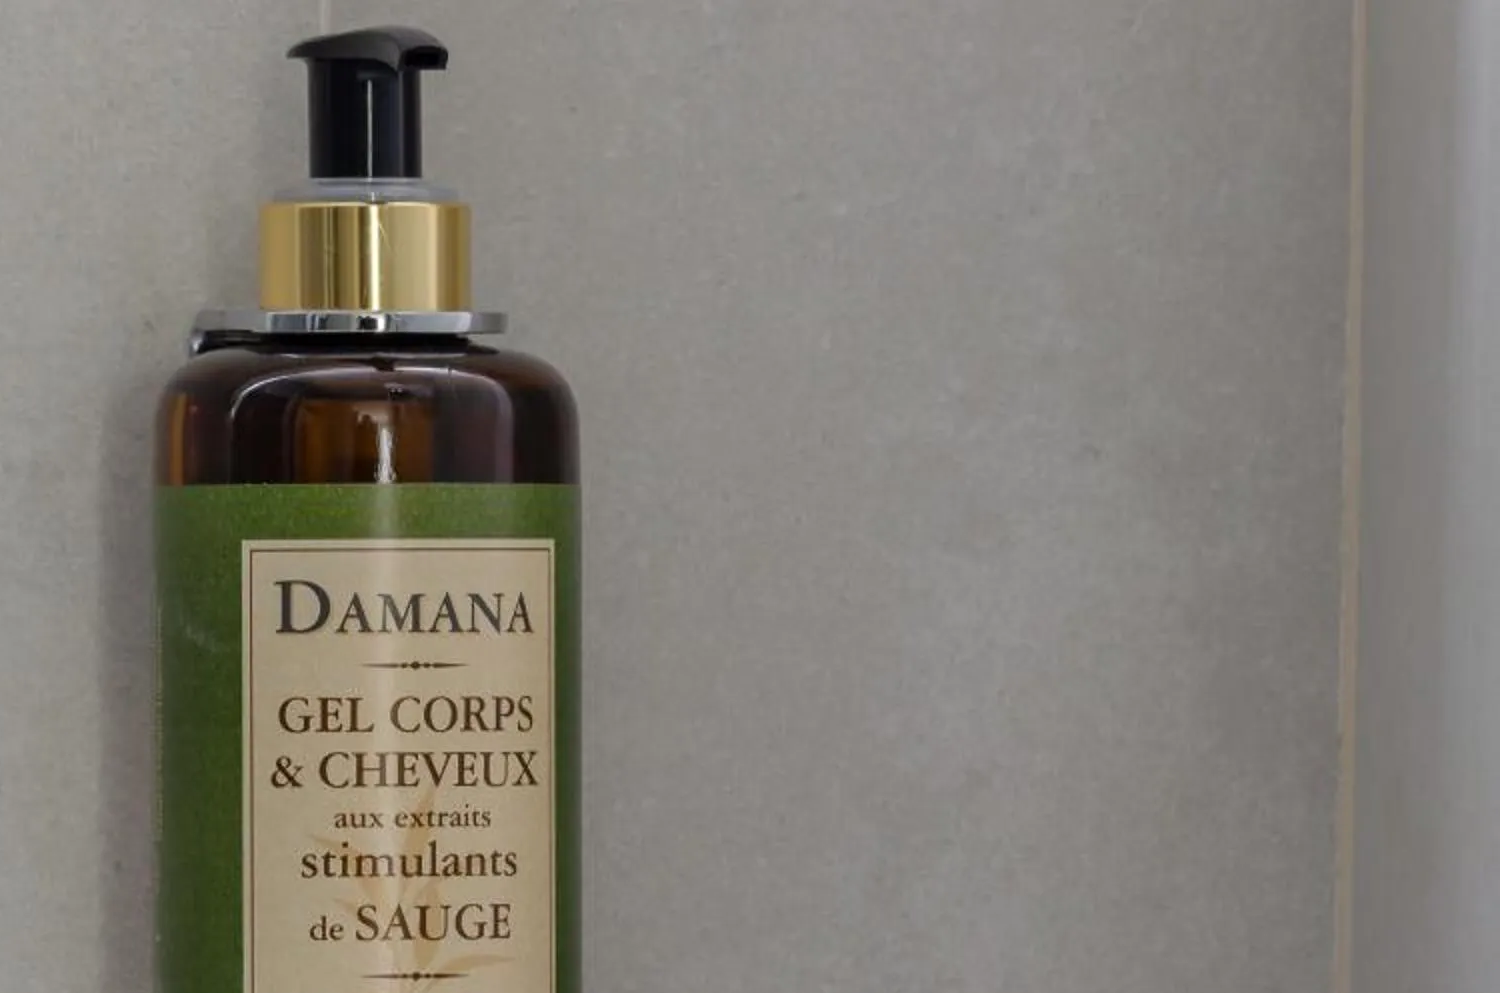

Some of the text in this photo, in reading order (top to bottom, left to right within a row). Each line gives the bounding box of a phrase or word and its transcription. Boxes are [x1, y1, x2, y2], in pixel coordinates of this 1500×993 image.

[273, 579, 535, 635] DAMANA
[277, 695, 534, 734] GEL CORPS
[270, 751, 539, 788] & CHEVEUX
[334, 804, 492, 830] aux extraits
[300, 840, 518, 879] stimulants
[309, 903, 511, 941] de SAUGE
